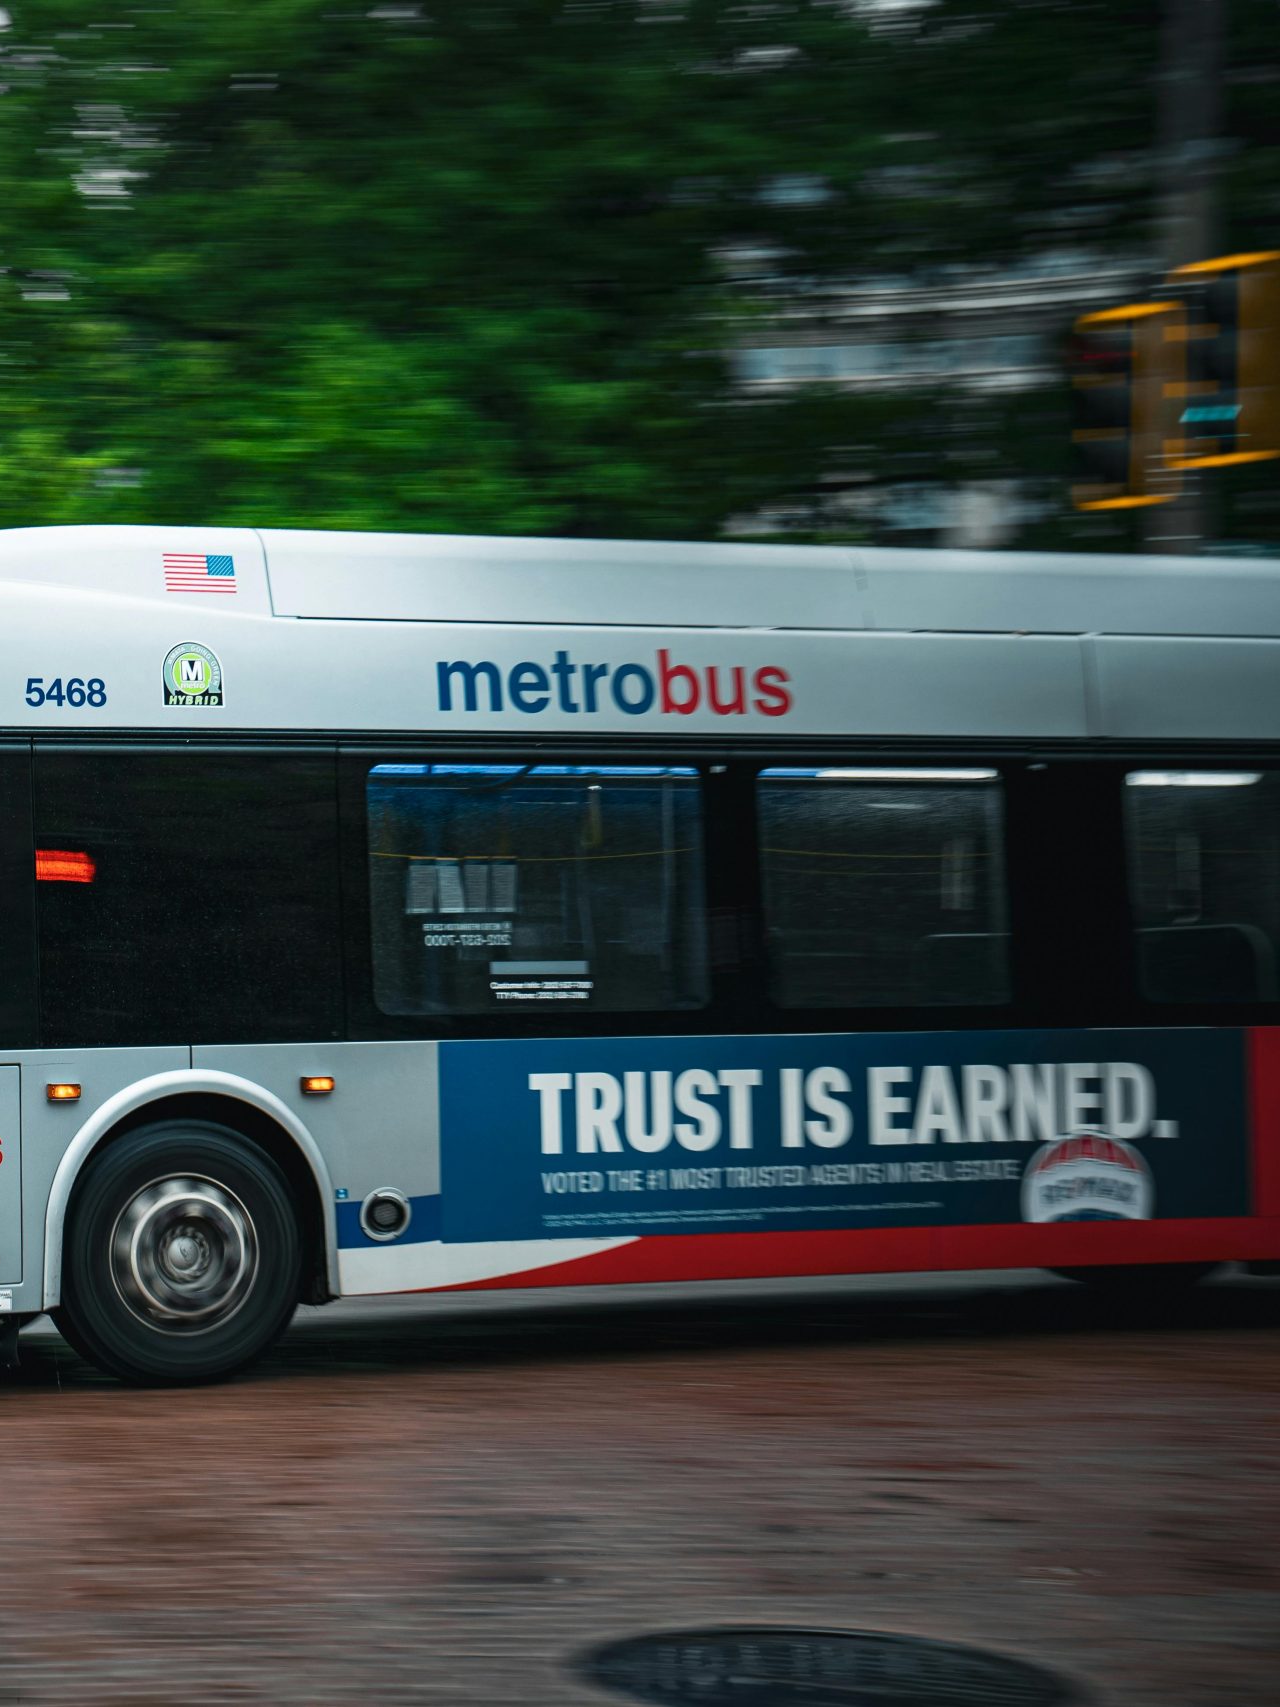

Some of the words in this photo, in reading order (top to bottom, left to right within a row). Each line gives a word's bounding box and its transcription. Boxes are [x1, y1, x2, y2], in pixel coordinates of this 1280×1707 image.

[181, 660, 203, 681] M
[437, 648, 794, 717] metrobus
[25, 677, 107, 708] 5468
[169, 695, 219, 705] HYBRID
[529, 1069, 761, 1155] TRUST
[781, 1067, 851, 1149] IS
[868, 1061, 1179, 1146] EARNED.
[541, 1171, 604, 1194] VOTED
[607, 1170, 645, 1192] THE
[646, 1169, 668, 1191] #1
[670, 1168, 722, 1190] MOST
[725, 1165, 807, 1188] TRUSTED
[809, 1163, 883, 1186] AGENTS
[905, 1161, 953, 1183] REAL
